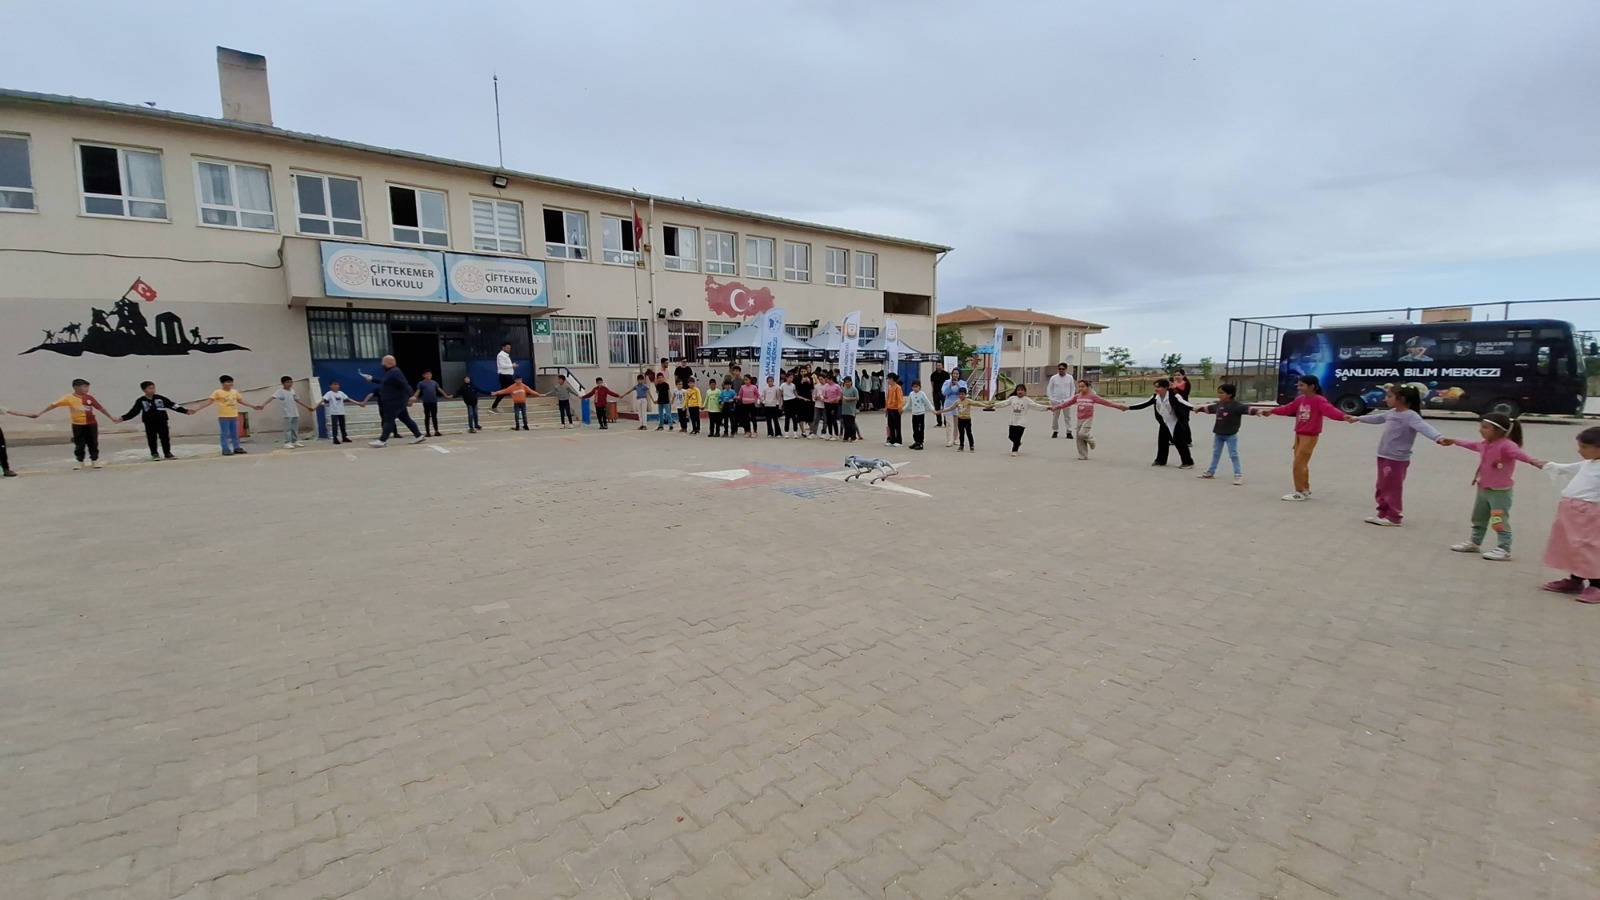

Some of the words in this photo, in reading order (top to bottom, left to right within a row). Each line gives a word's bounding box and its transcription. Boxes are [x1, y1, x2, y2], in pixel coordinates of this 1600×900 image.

[370, 264, 434, 278] ÇİFTEKEMER
[371, 276, 423, 289] İLKOKULU
[485, 272, 538, 285] ÇİFTEKEMER
[486, 285, 538, 296] ORTAOKULU
[1334, 368, 1399, 378] ŞANLIURFA
[1441, 367, 1501, 377] MERKEZİ
